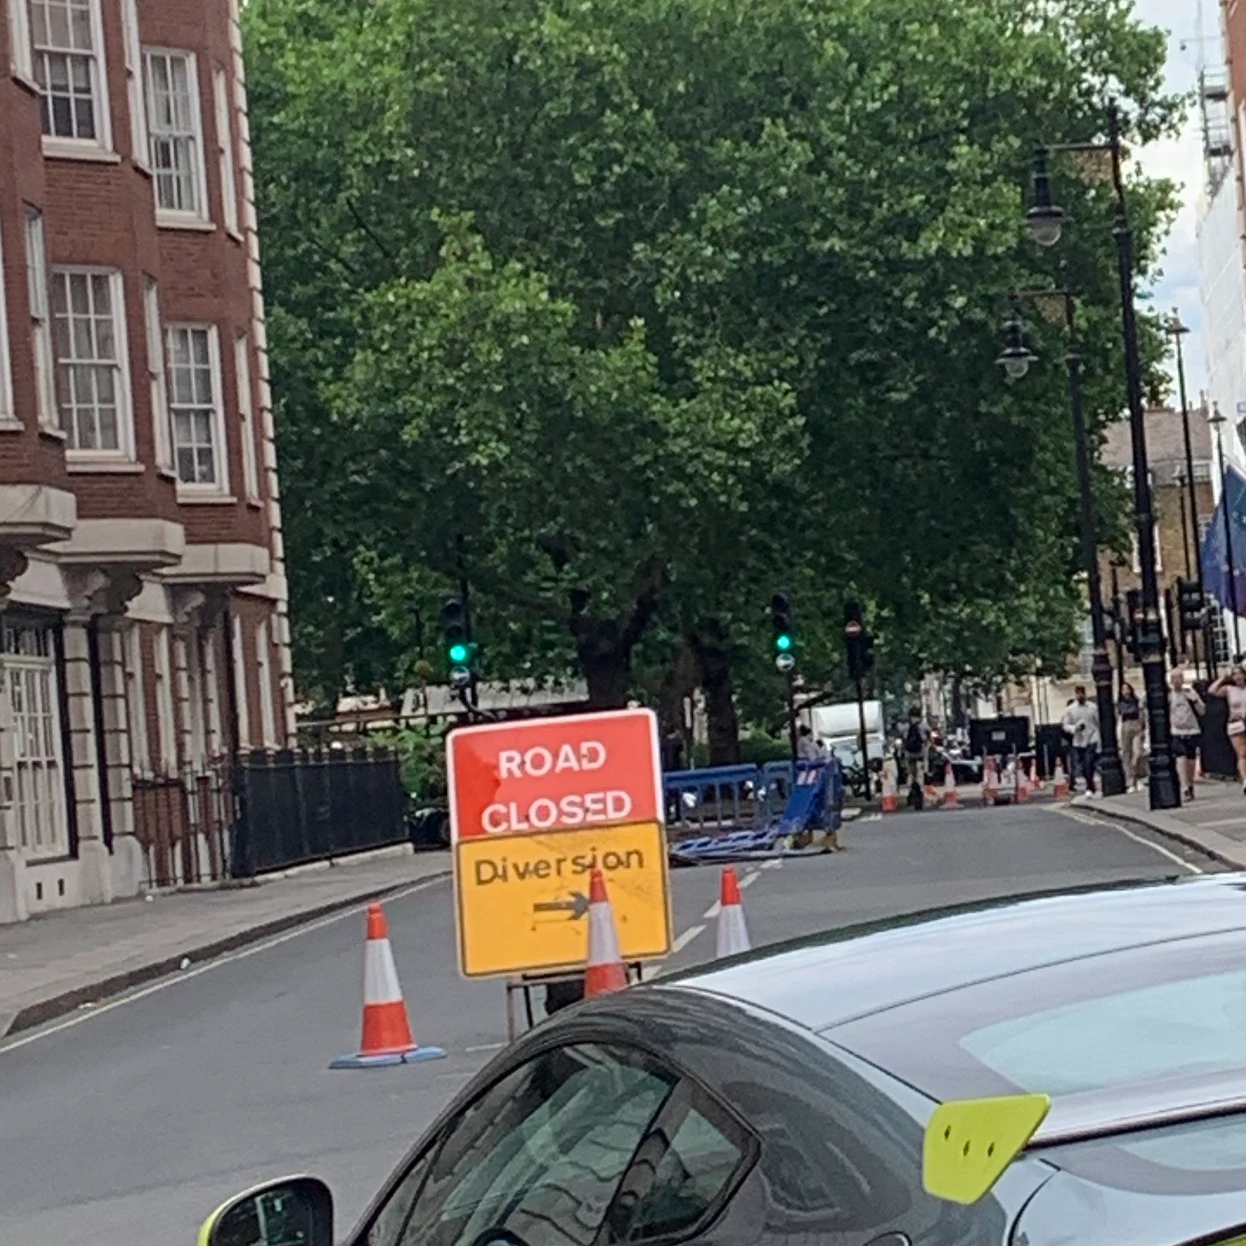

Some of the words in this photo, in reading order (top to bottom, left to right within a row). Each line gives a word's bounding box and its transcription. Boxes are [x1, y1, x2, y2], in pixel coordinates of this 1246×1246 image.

[499, 741, 606, 779] ROAD
[481, 790, 632, 833] CLOSED
[475, 847, 644, 886] Diversion
